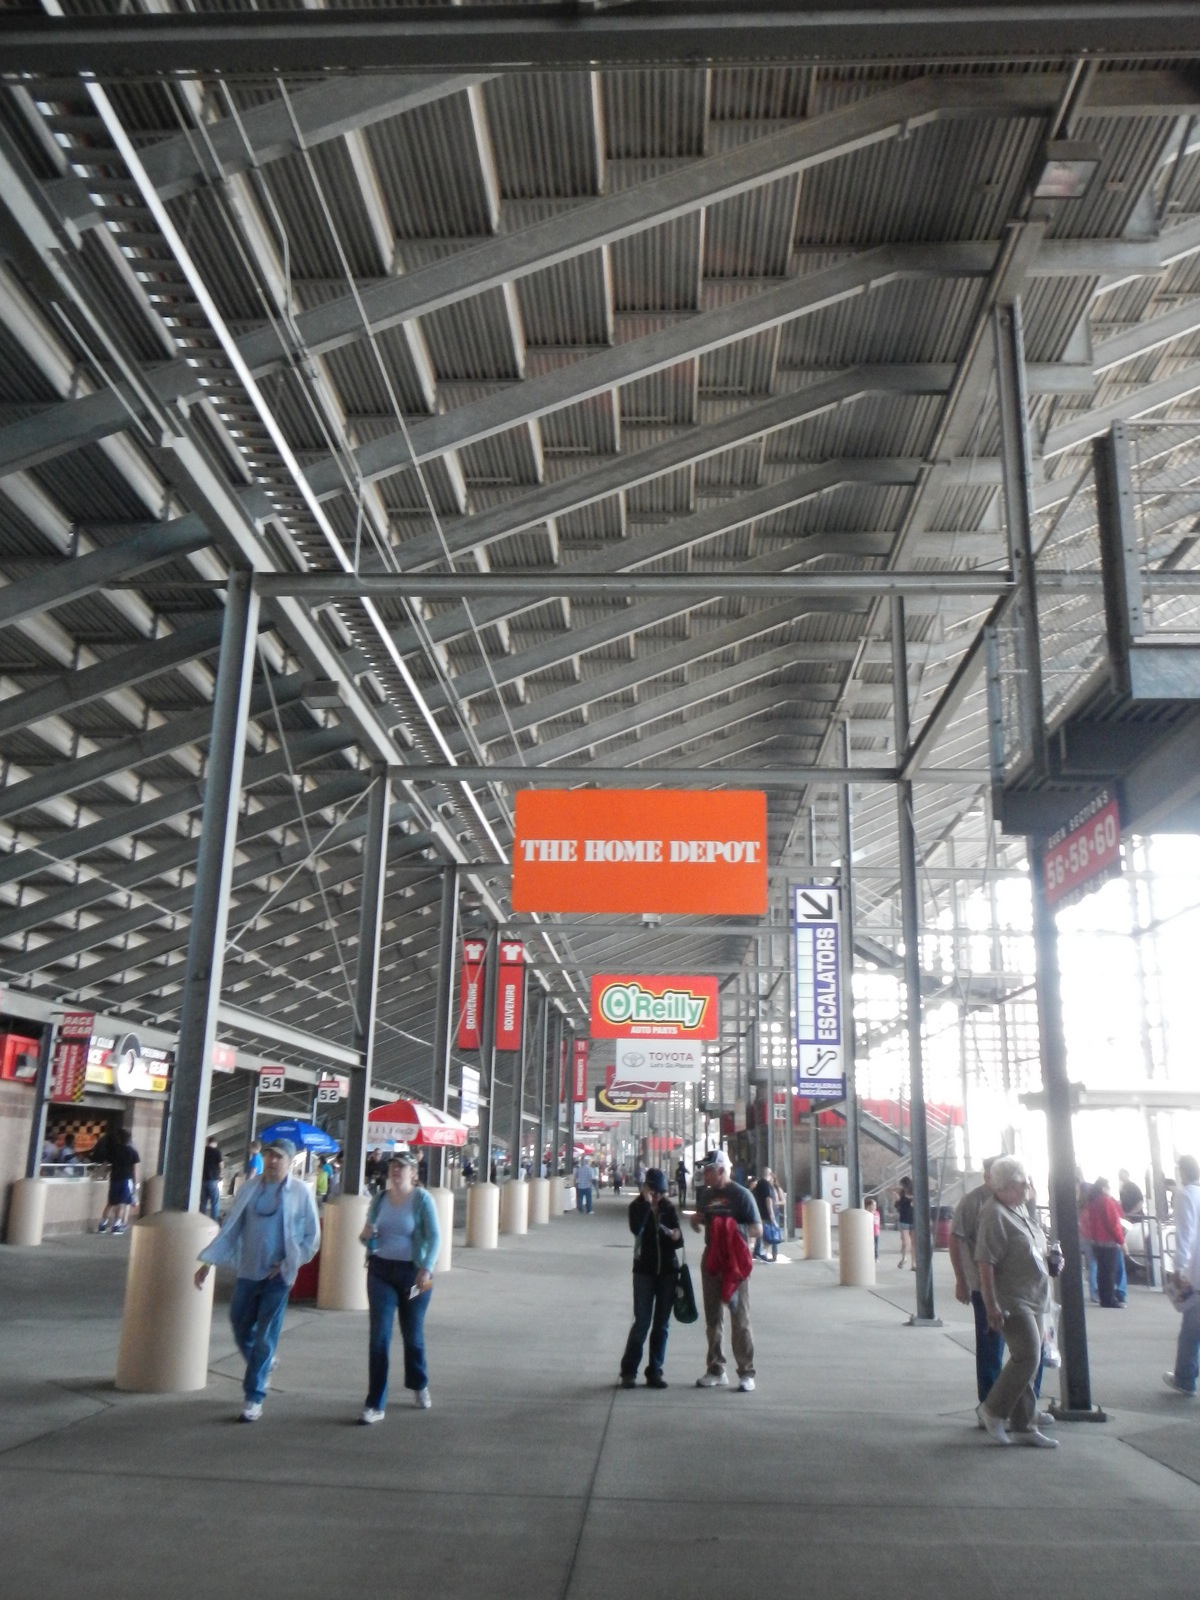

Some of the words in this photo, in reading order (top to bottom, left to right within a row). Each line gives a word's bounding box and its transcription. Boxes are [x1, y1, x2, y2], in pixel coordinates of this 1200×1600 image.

[520, 839, 578, 862] THE
[584, 840, 663, 862] HOME
[669, 840, 761, 863] DEPOT
[816, 927, 838, 1040] ESCALATORS
[465, 983, 478, 1030] SOUVENIRS
[503, 984, 516, 1031] SOUVENIRS
[603, 985, 704, 1026] O'Reilly
[65, 1016, 94, 1025] RACE
[62, 1026, 92, 1035] GEAR
[630, 1026, 651, 1035] AUTO
[652, 1026, 678, 1035] PARTS
[649, 1052, 694, 1061] TOYOTA
[261, 1077, 282, 1090] 54
[320, 1090, 338, 1101] 52
[830, 1172, 842, 1214] ICE
